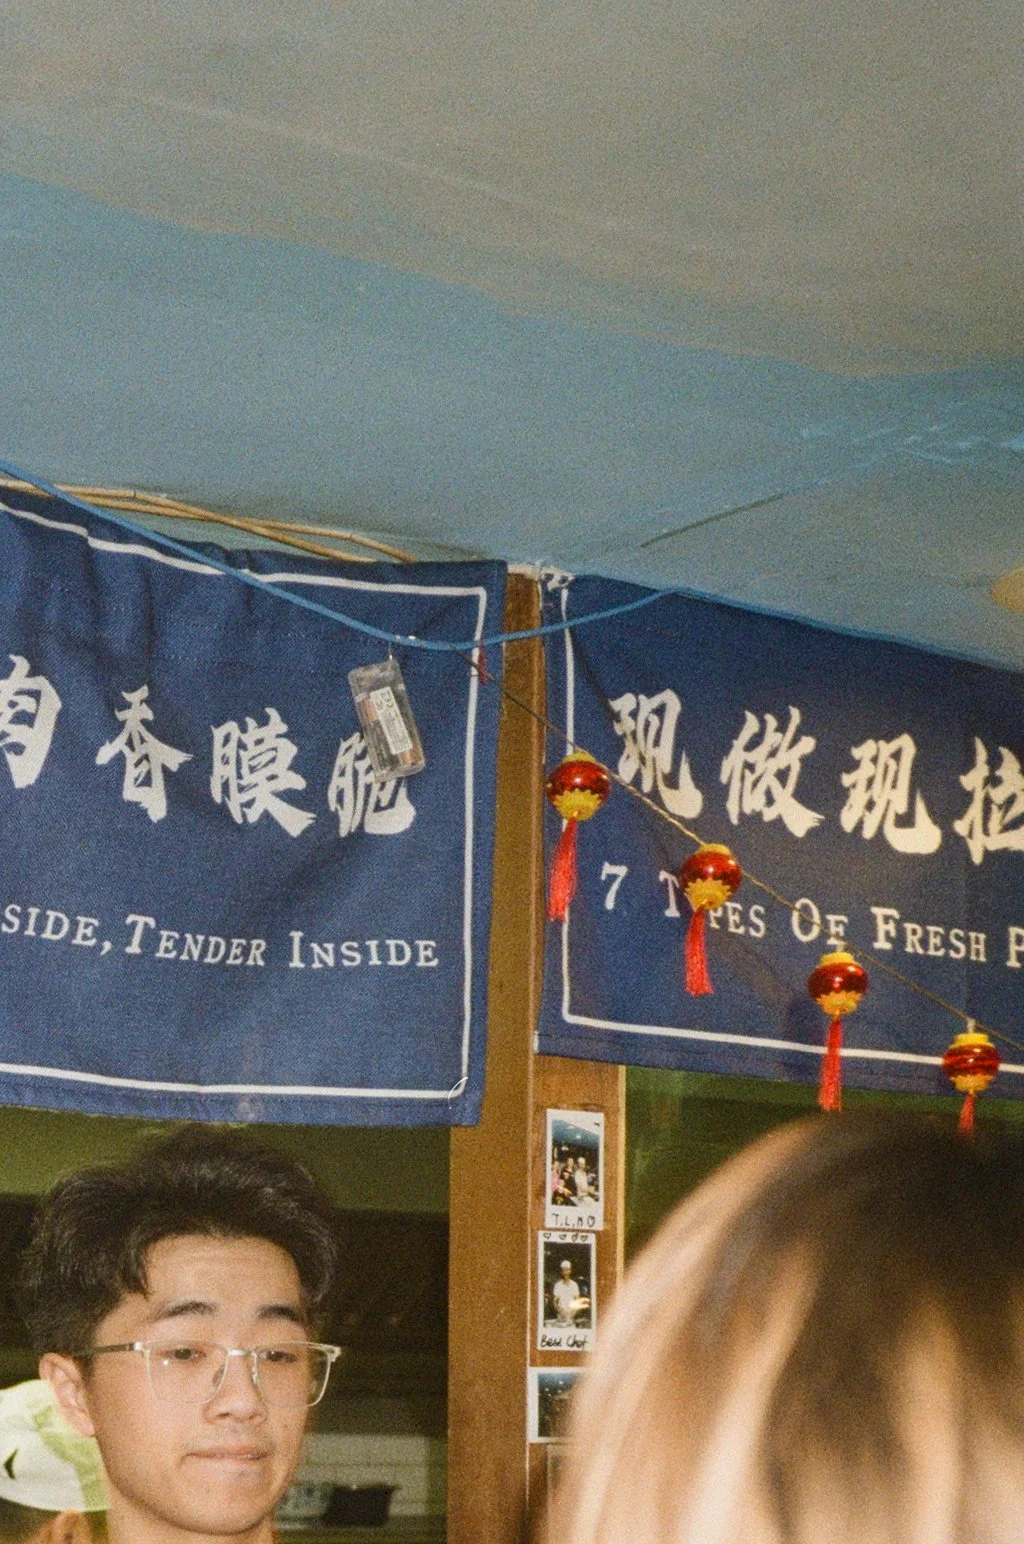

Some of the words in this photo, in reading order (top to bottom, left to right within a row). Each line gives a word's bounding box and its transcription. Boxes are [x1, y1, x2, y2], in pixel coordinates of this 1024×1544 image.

[600, 861, 628, 911] 7
[658, 868, 766, 938] TPES
[870, 906, 987, 962] FRESH
